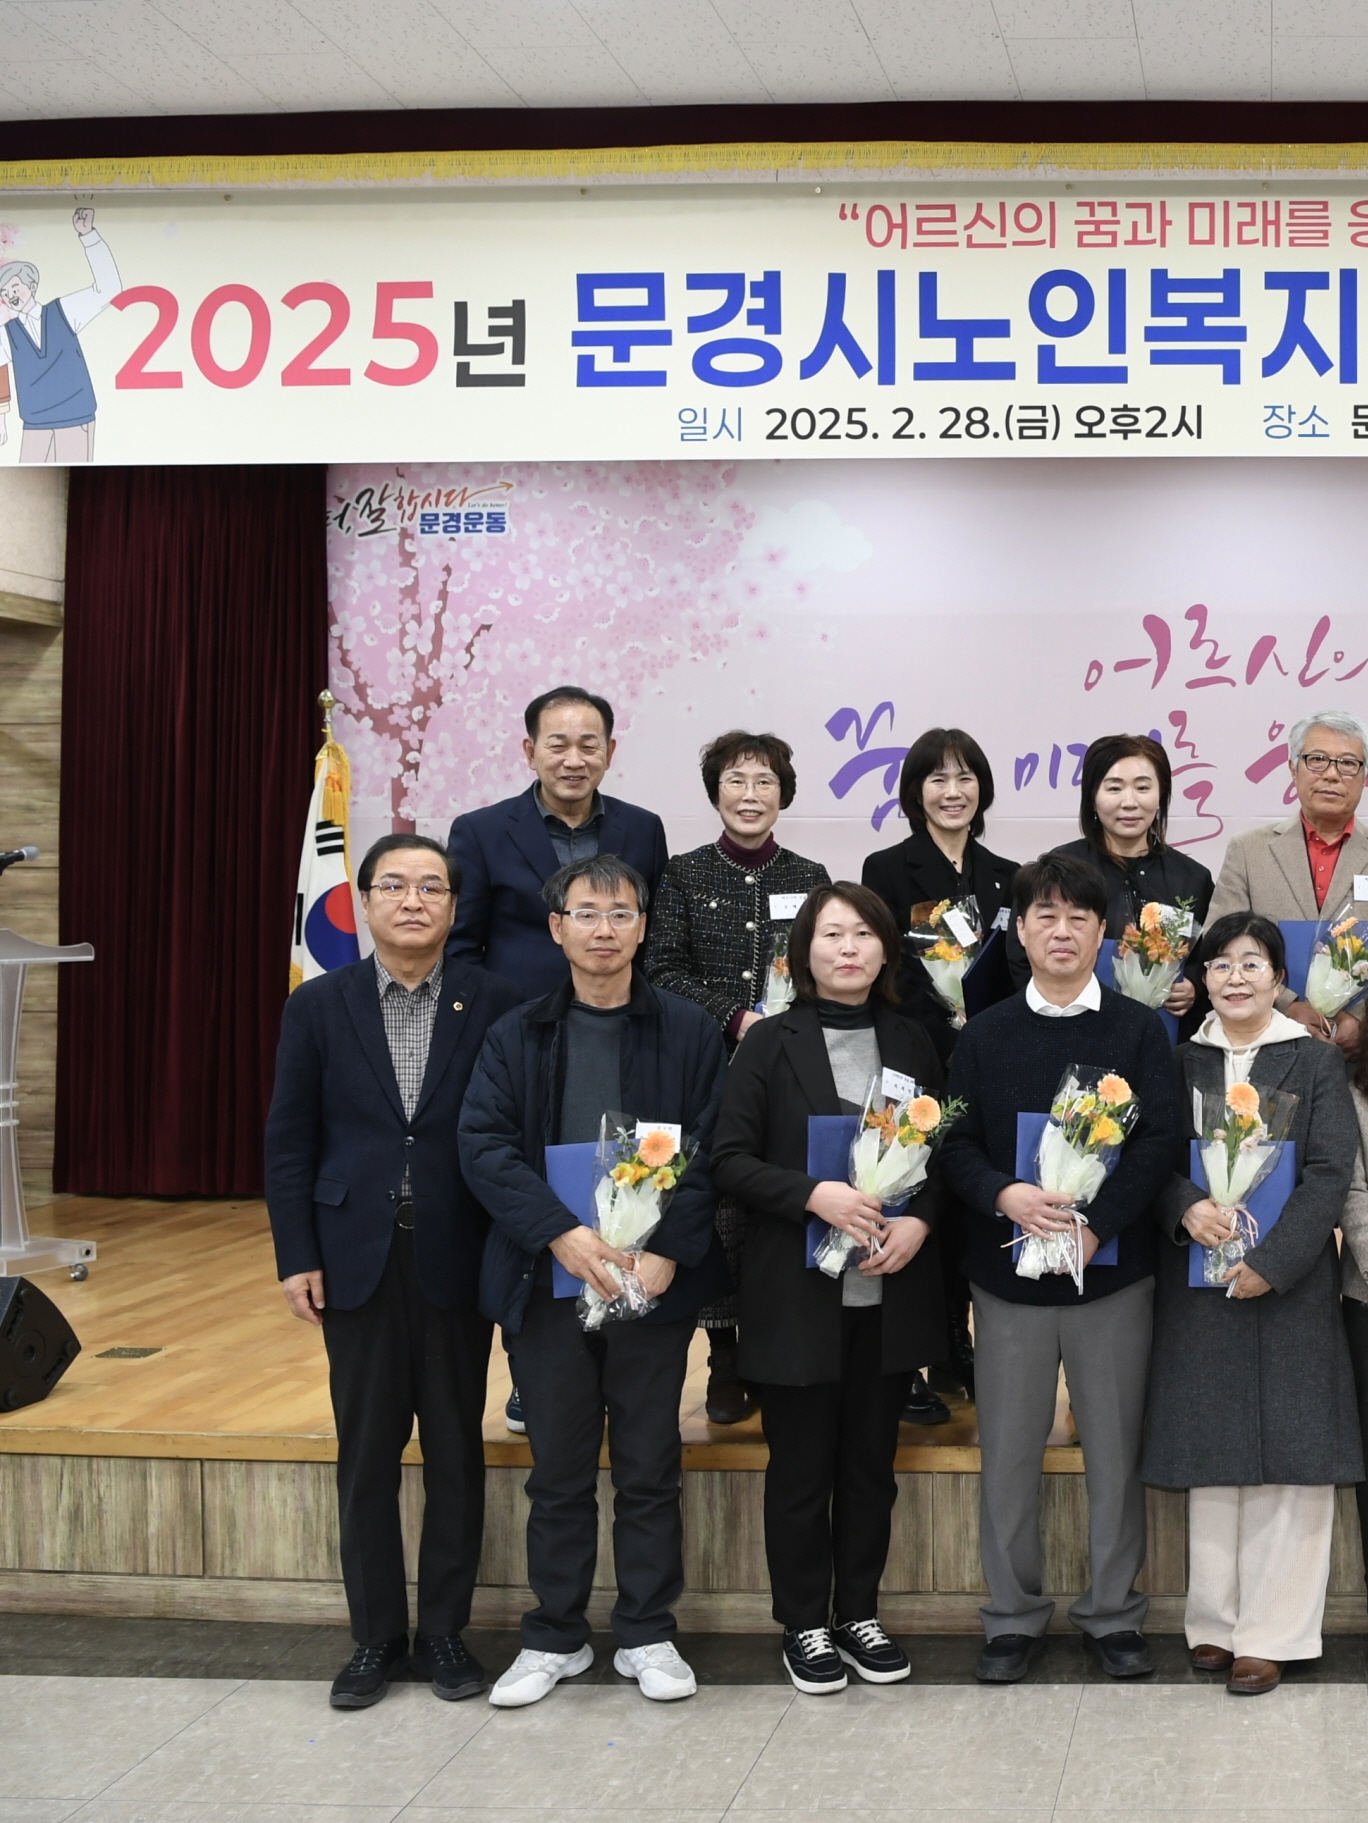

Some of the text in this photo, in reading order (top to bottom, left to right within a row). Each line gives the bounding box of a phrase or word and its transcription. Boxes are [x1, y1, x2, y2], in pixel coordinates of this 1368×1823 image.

[1075, 201, 1173, 248] 꿈과
[1188, 200, 1332, 247] 미래를
[109, 281, 527, 389] 2025년
[678, 404, 1203, 441] 일시 2025. 2. 28.(금) 오후2시
[1263, 405, 1331, 439] 장소
[419, 511, 506, 535] 문경운동
